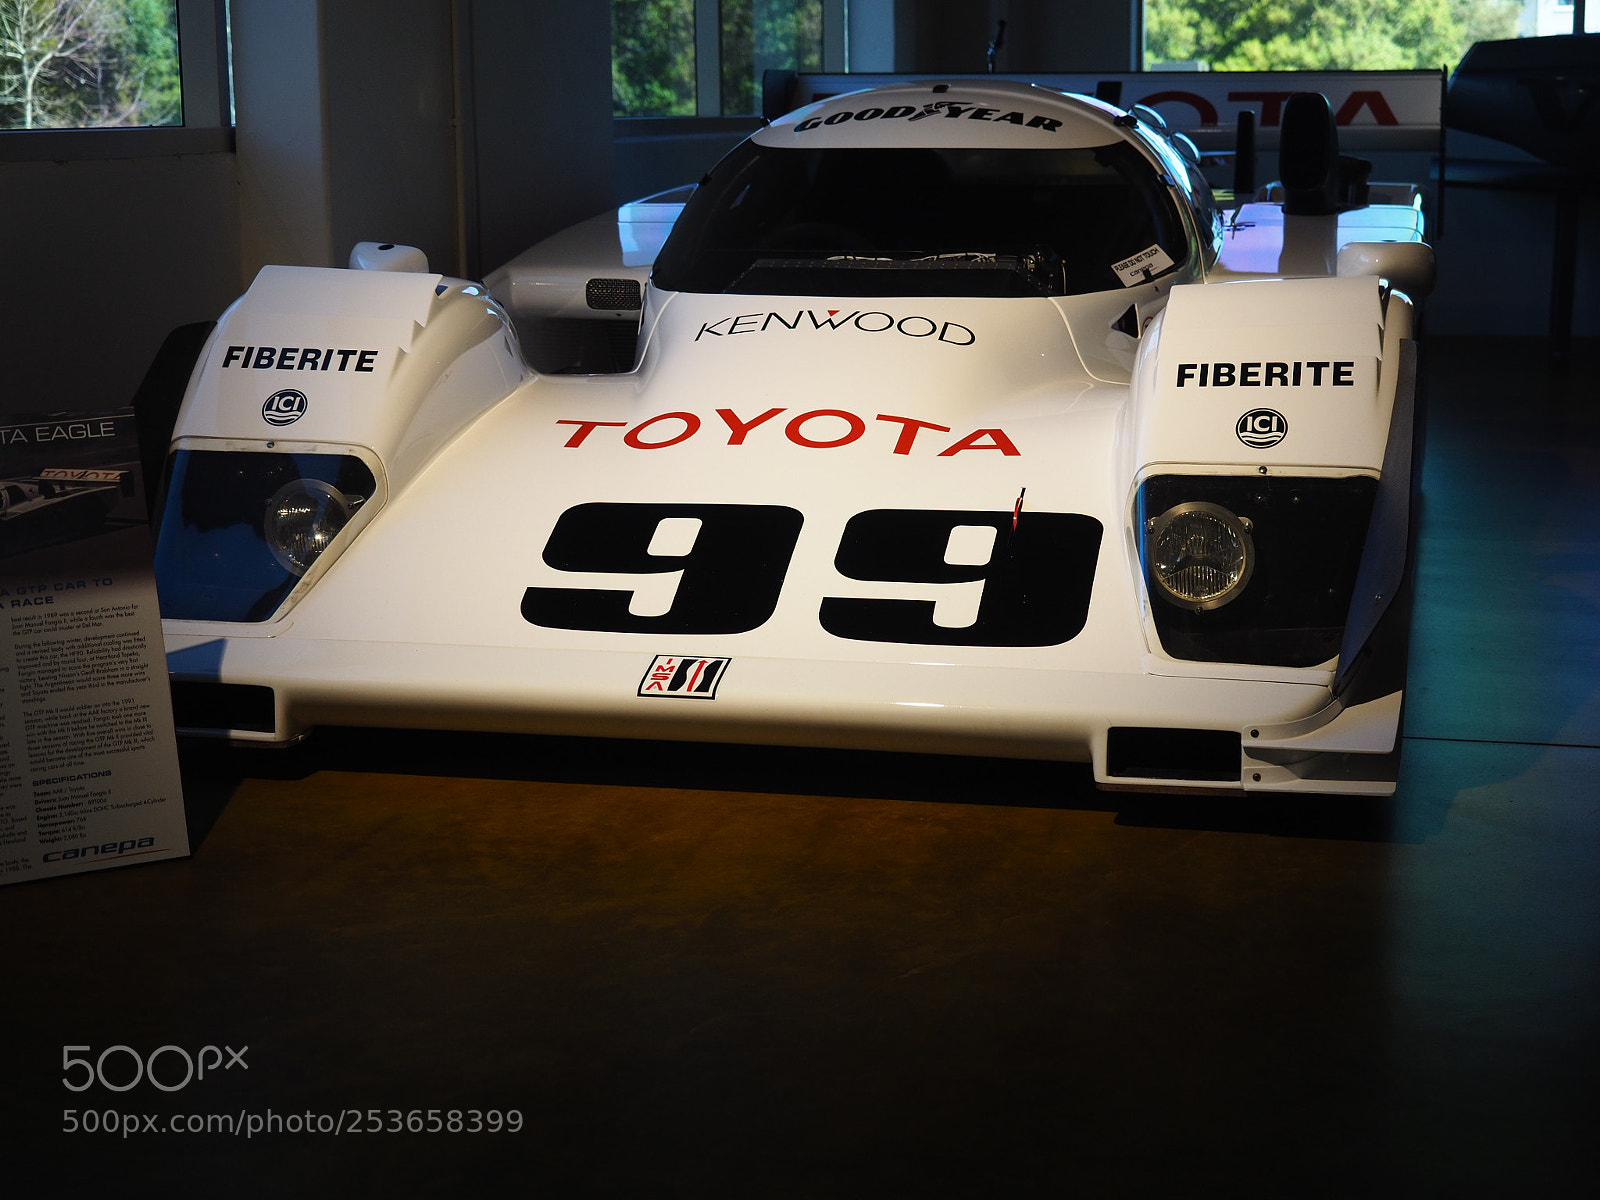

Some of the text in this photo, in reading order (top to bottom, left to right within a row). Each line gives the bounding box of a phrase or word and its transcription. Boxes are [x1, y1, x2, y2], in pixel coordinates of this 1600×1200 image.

[695, 310, 975, 345] KENWOOD
[222, 346, 378, 372] FIBERITE
[1177, 362, 1354, 387] FIBERITE
[35, 421, 116, 442] EAGLE
[558, 408, 1020, 456] TOYOTA
[16, 584, 47, 596] GTP
[54, 580, 86, 592] CAR
[93, 577, 113, 588] TO
[521, 502, 1105, 647] 99
[11, 596, 54, 608] RACE
[32, 770, 112, 787] SPECIFICATIONS
[42, 837, 155, 864] canepa
